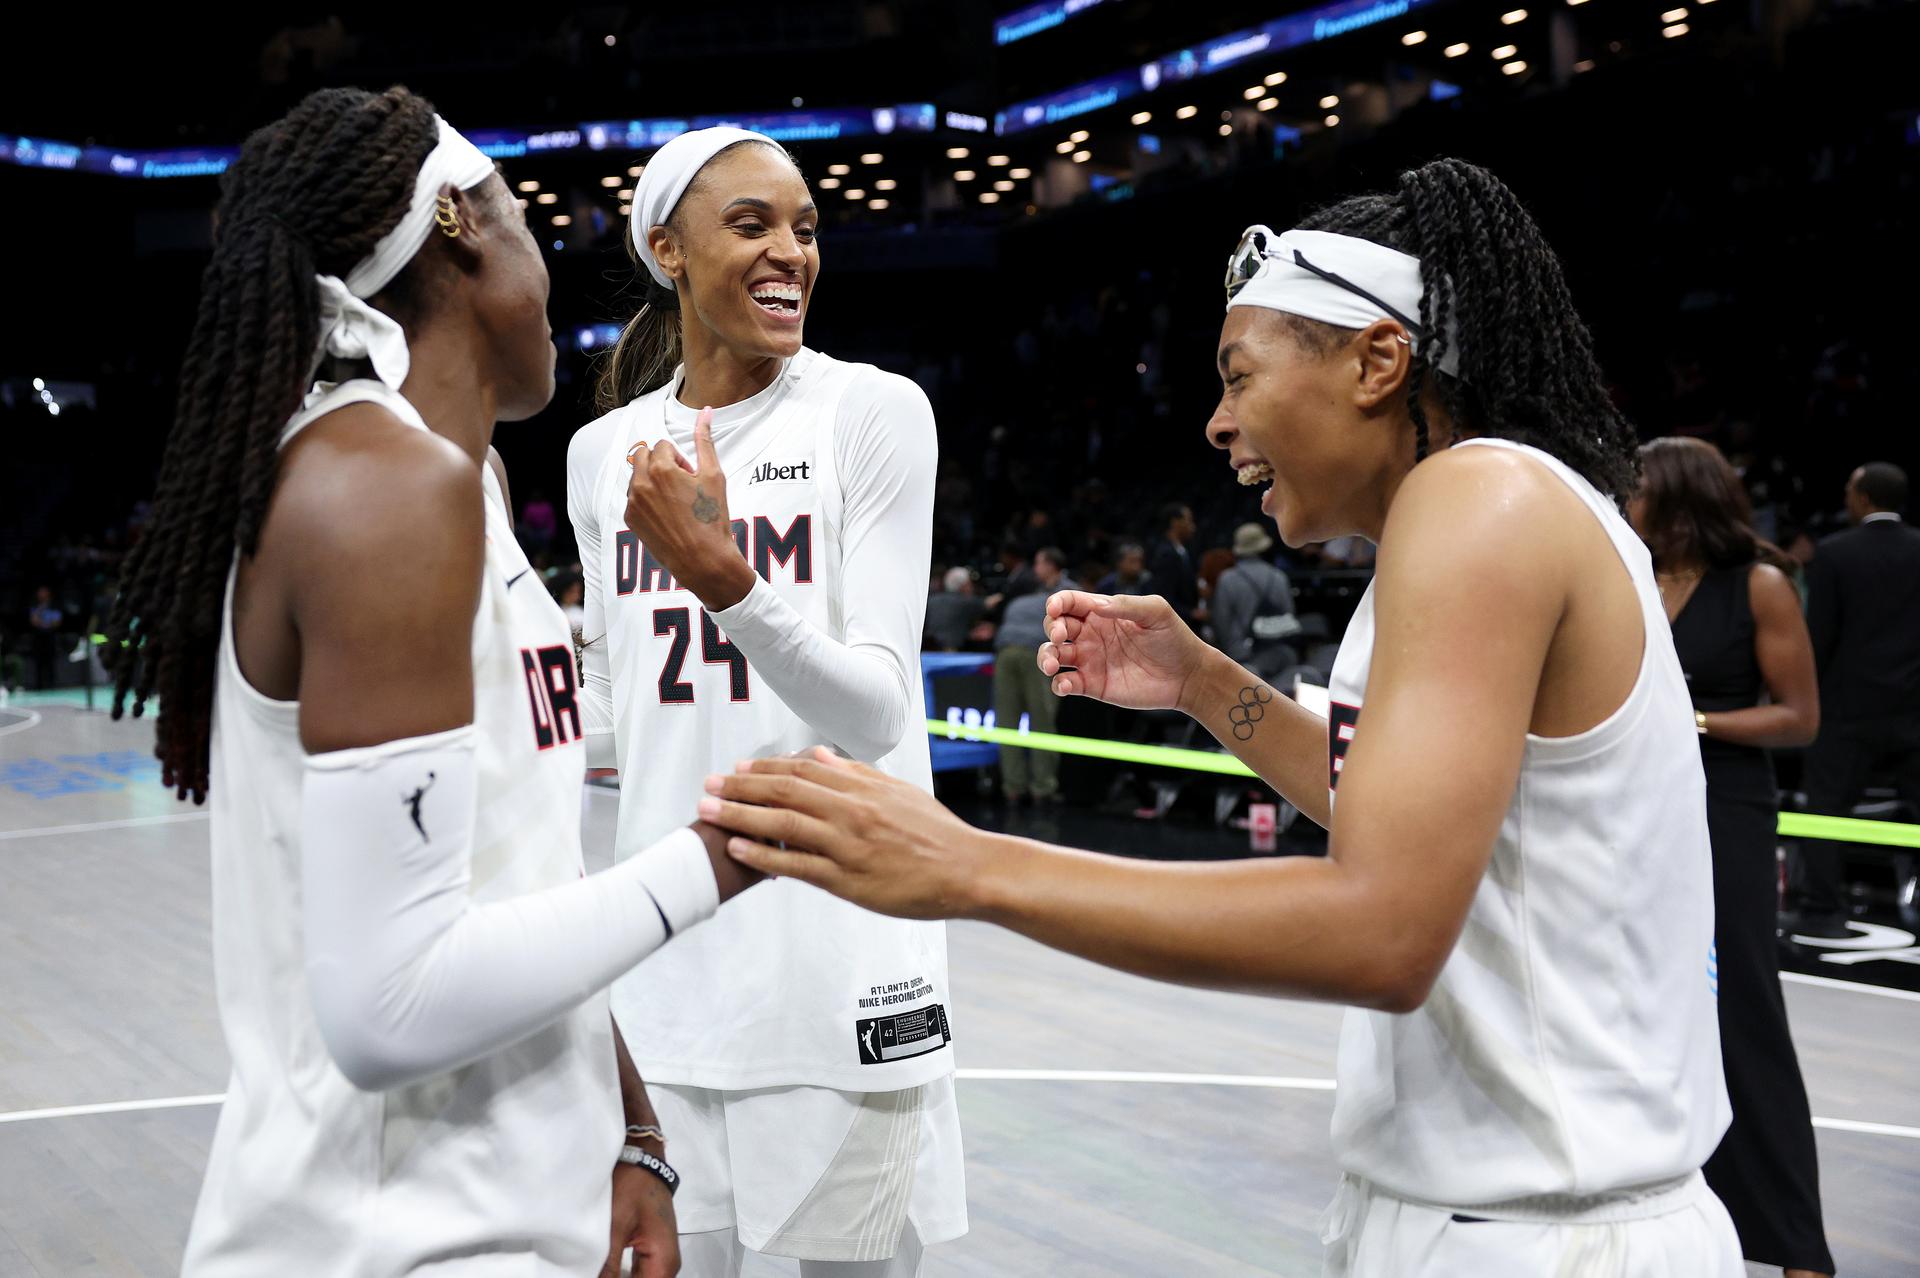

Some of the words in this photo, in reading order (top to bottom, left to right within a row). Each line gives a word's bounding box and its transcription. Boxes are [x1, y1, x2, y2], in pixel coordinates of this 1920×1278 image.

[749, 461, 810, 485] Albert
[653, 606, 750, 704] 24
[858, 997, 880, 1008] NIKE
[881, 990, 917, 1006] HEROINE
[916, 984, 934, 998] EDITION
[871, 981, 909, 996] ATLANTA
[884, 1028, 893, 1038] 42
